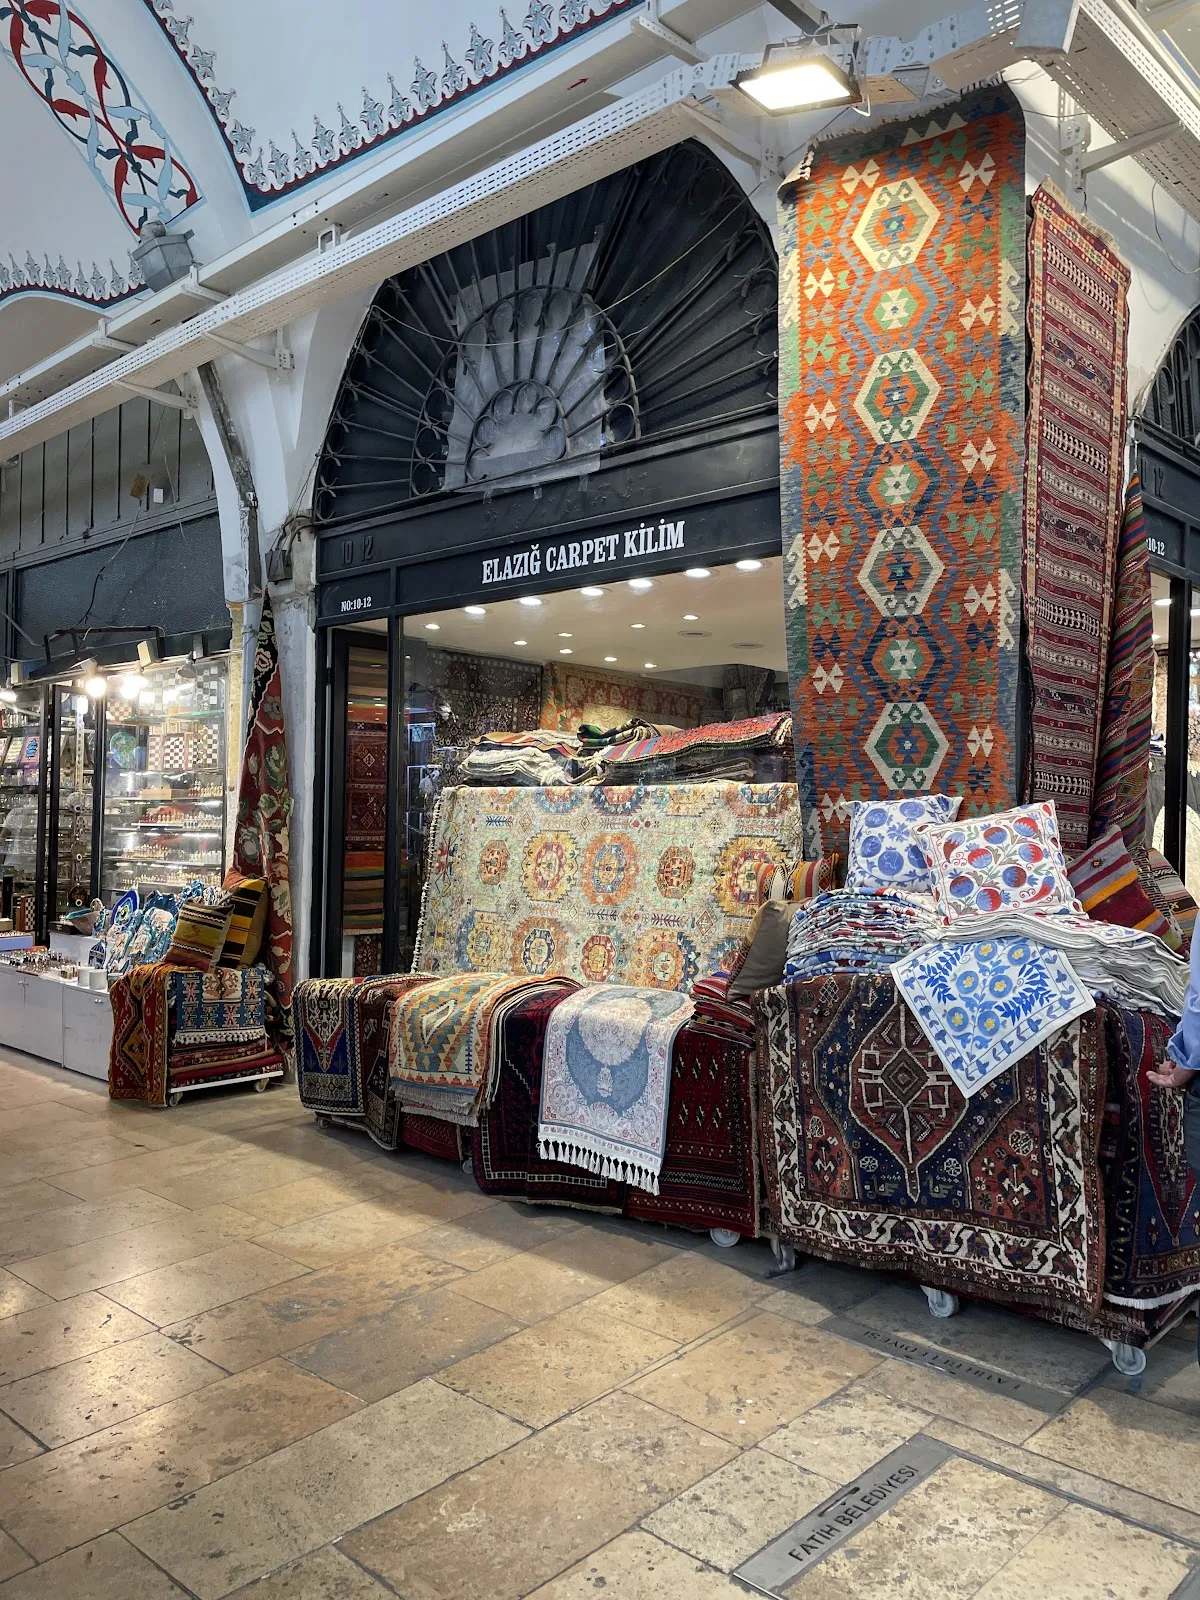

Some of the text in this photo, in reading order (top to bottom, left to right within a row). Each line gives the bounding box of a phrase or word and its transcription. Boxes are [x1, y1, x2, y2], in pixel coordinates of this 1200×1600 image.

[482, 518, 685, 584] ELAZIĞ CARPET KİLİM
[340, 596, 372, 612] NO:10-12
[788, 1524, 842, 1562] FATİH
